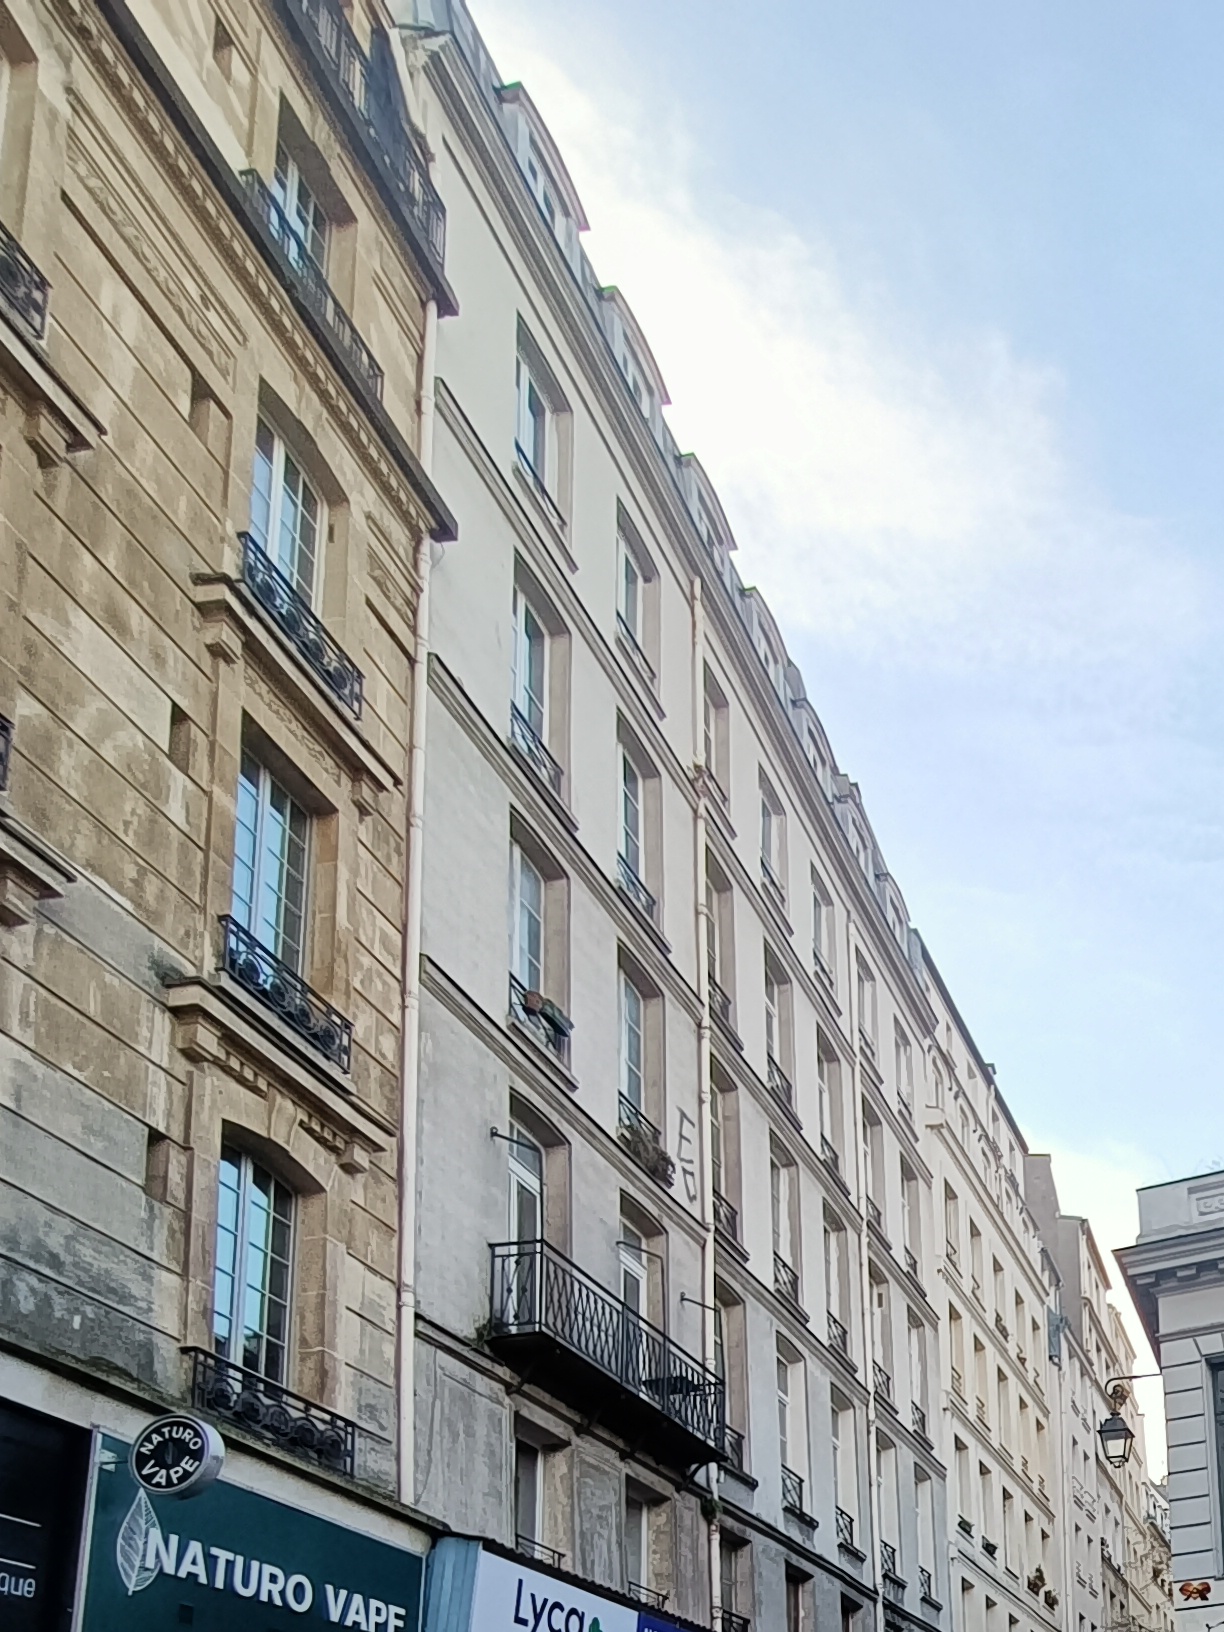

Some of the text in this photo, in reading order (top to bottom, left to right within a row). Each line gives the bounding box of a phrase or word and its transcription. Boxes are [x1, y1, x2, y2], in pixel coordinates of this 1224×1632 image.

[139, 1426, 202, 1455] NATURO
[141, 1456, 200, 1486] VAPE
[145, 1528, 313, 1613] NATURO
